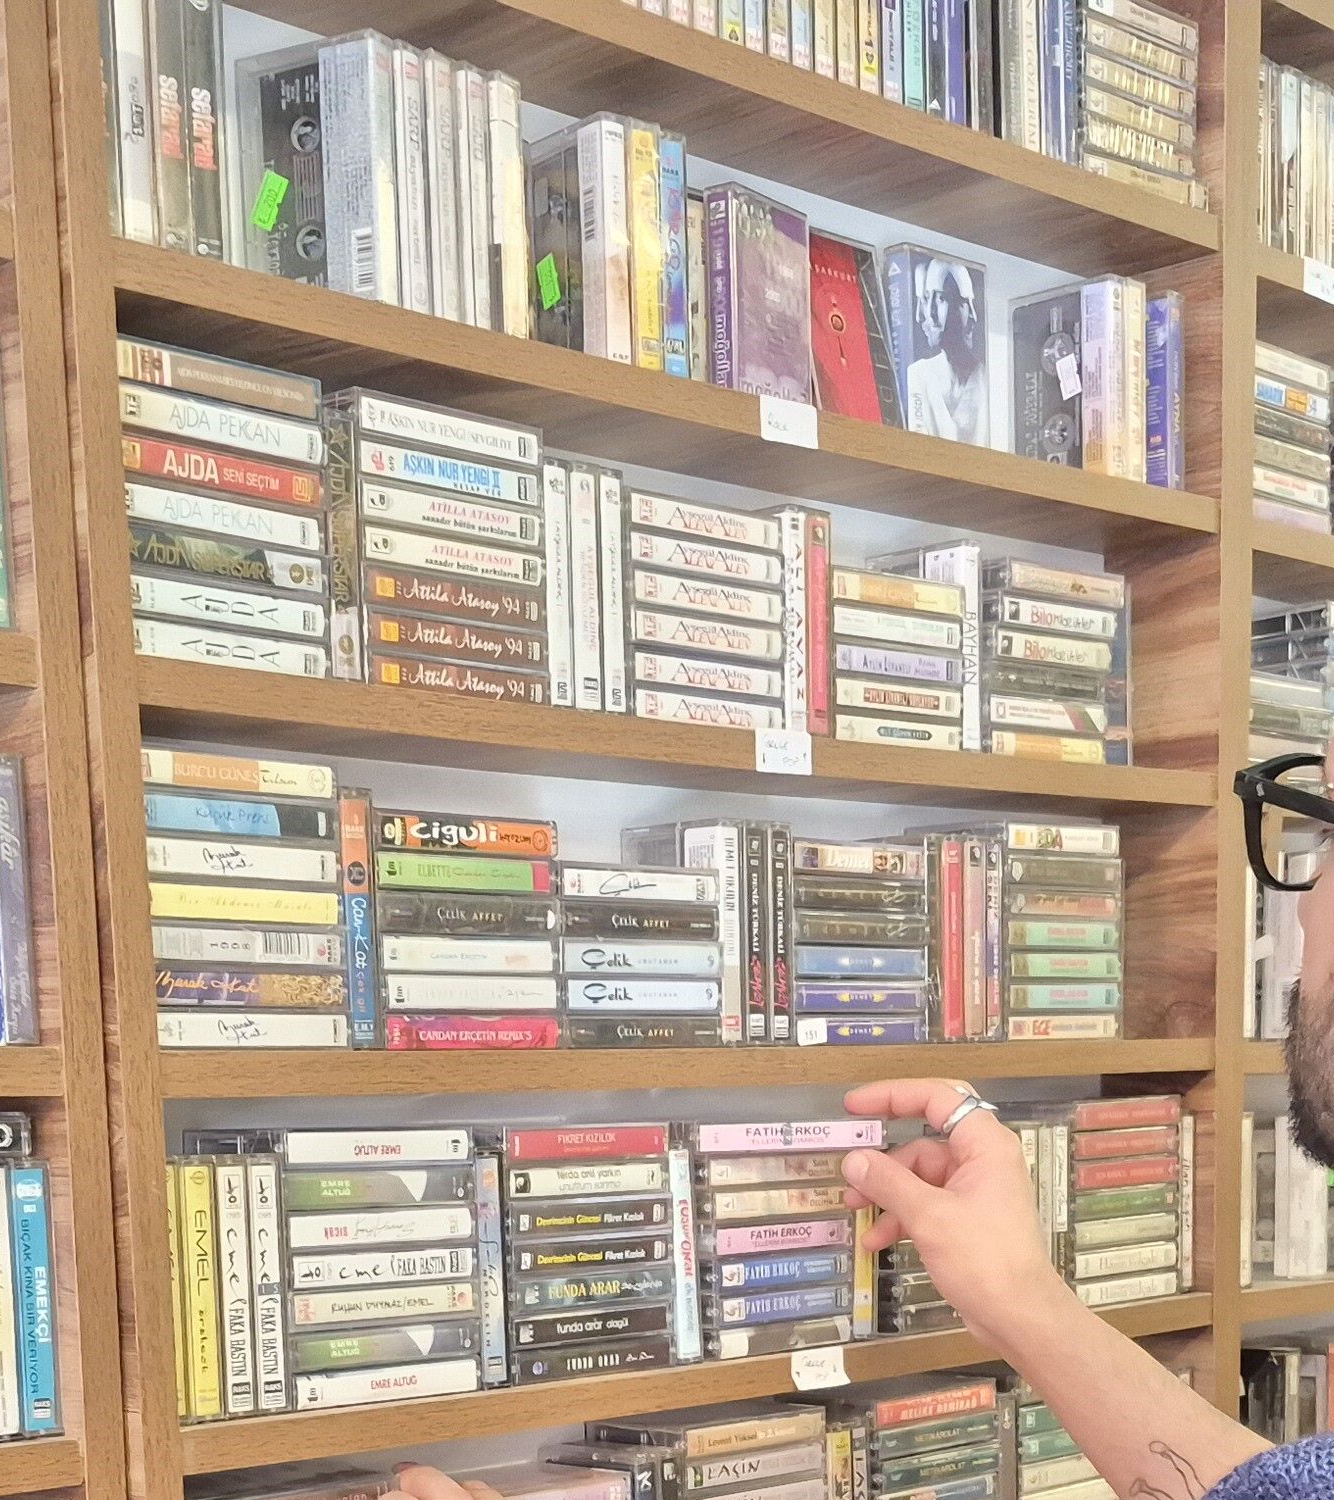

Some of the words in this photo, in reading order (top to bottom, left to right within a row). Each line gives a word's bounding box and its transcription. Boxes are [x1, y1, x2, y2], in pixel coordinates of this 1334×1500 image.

[162, 452, 220, 486] AJDA
[31, 1265, 51, 1344] EMEKÇİ
[588, 1279, 621, 1298] ARAR
